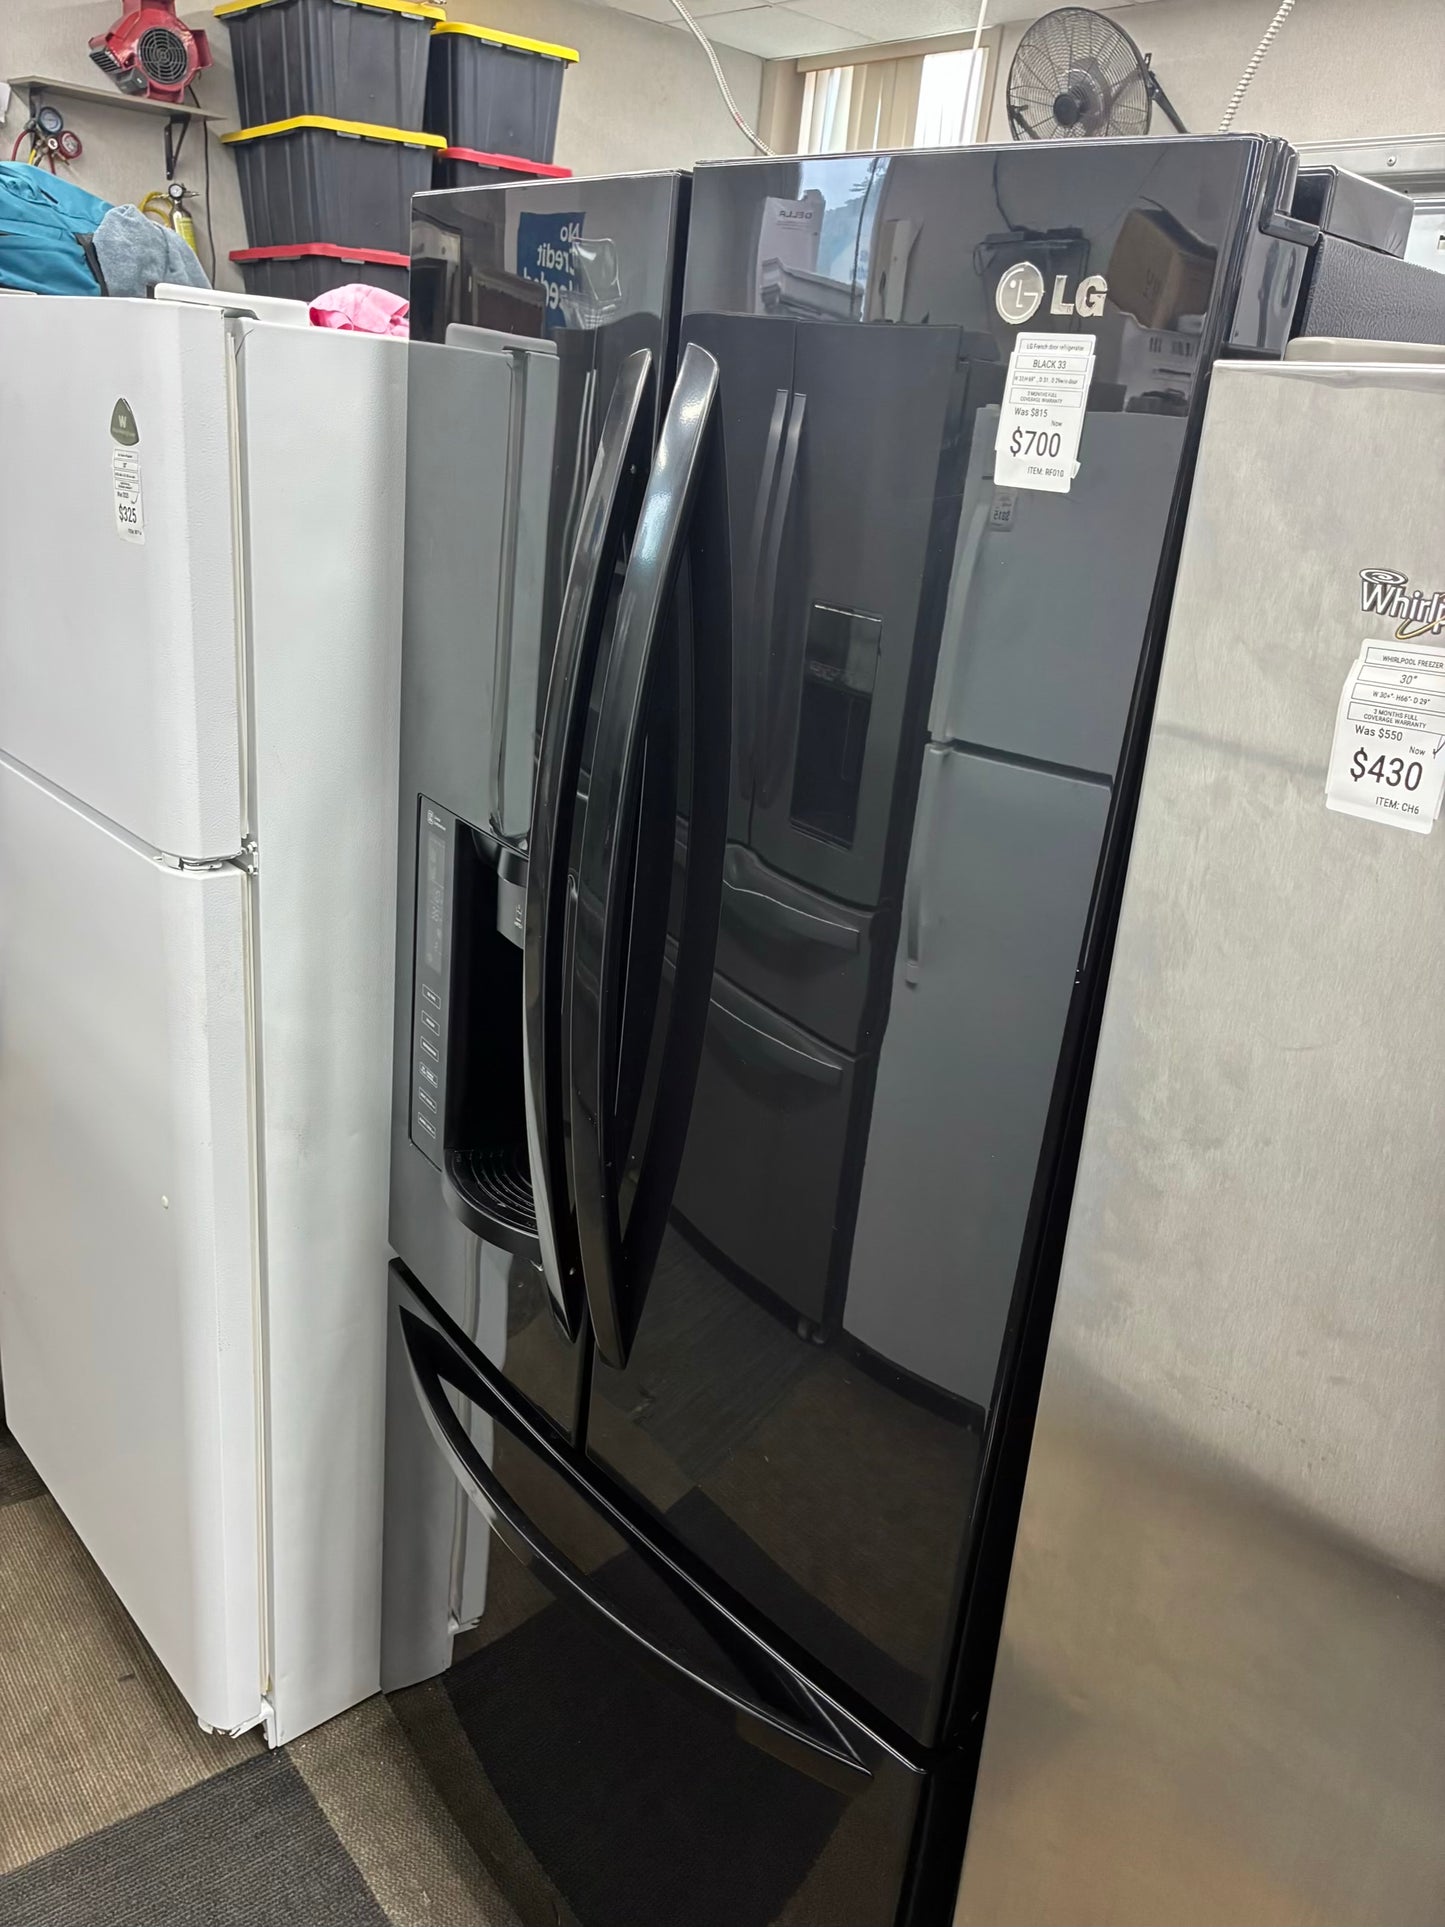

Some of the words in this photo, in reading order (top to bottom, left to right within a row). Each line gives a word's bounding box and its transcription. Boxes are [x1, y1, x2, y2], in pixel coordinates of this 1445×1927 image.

[1050, 274, 1108, 318] LG
[1032, 359, 1056, 368] BLACK
[1058, 360, 1066, 369] 33
[1014, 407, 1029, 416] Was
[1030, 408, 1048, 418] $815
[1010, 426, 1061, 458] $700
[1027, 466, 1043, 475] ITEM:
[1044, 468, 1064, 478] RF010
[119, 503, 137, 524] $325
[1382, 655, 1416, 666] WHIRLPOOL
[1417, 660, 1444, 668] FREEZER
[1400, 674, 1418, 684] 30"
[1363, 714, 1393, 724] COVERAGE
[1394, 717, 1426, 728] WARRANTY
[1378, 710, 1404, 719] MONTHS
[1354, 724, 1376, 736] Was
[1378, 728, 1403, 742] $550
[1409, 746, 1426, 756] Now
[1350, 747, 1423, 792] $430
[1376, 796, 1400, 810] ITEM:
[1401, 802, 1420, 814] CH6
